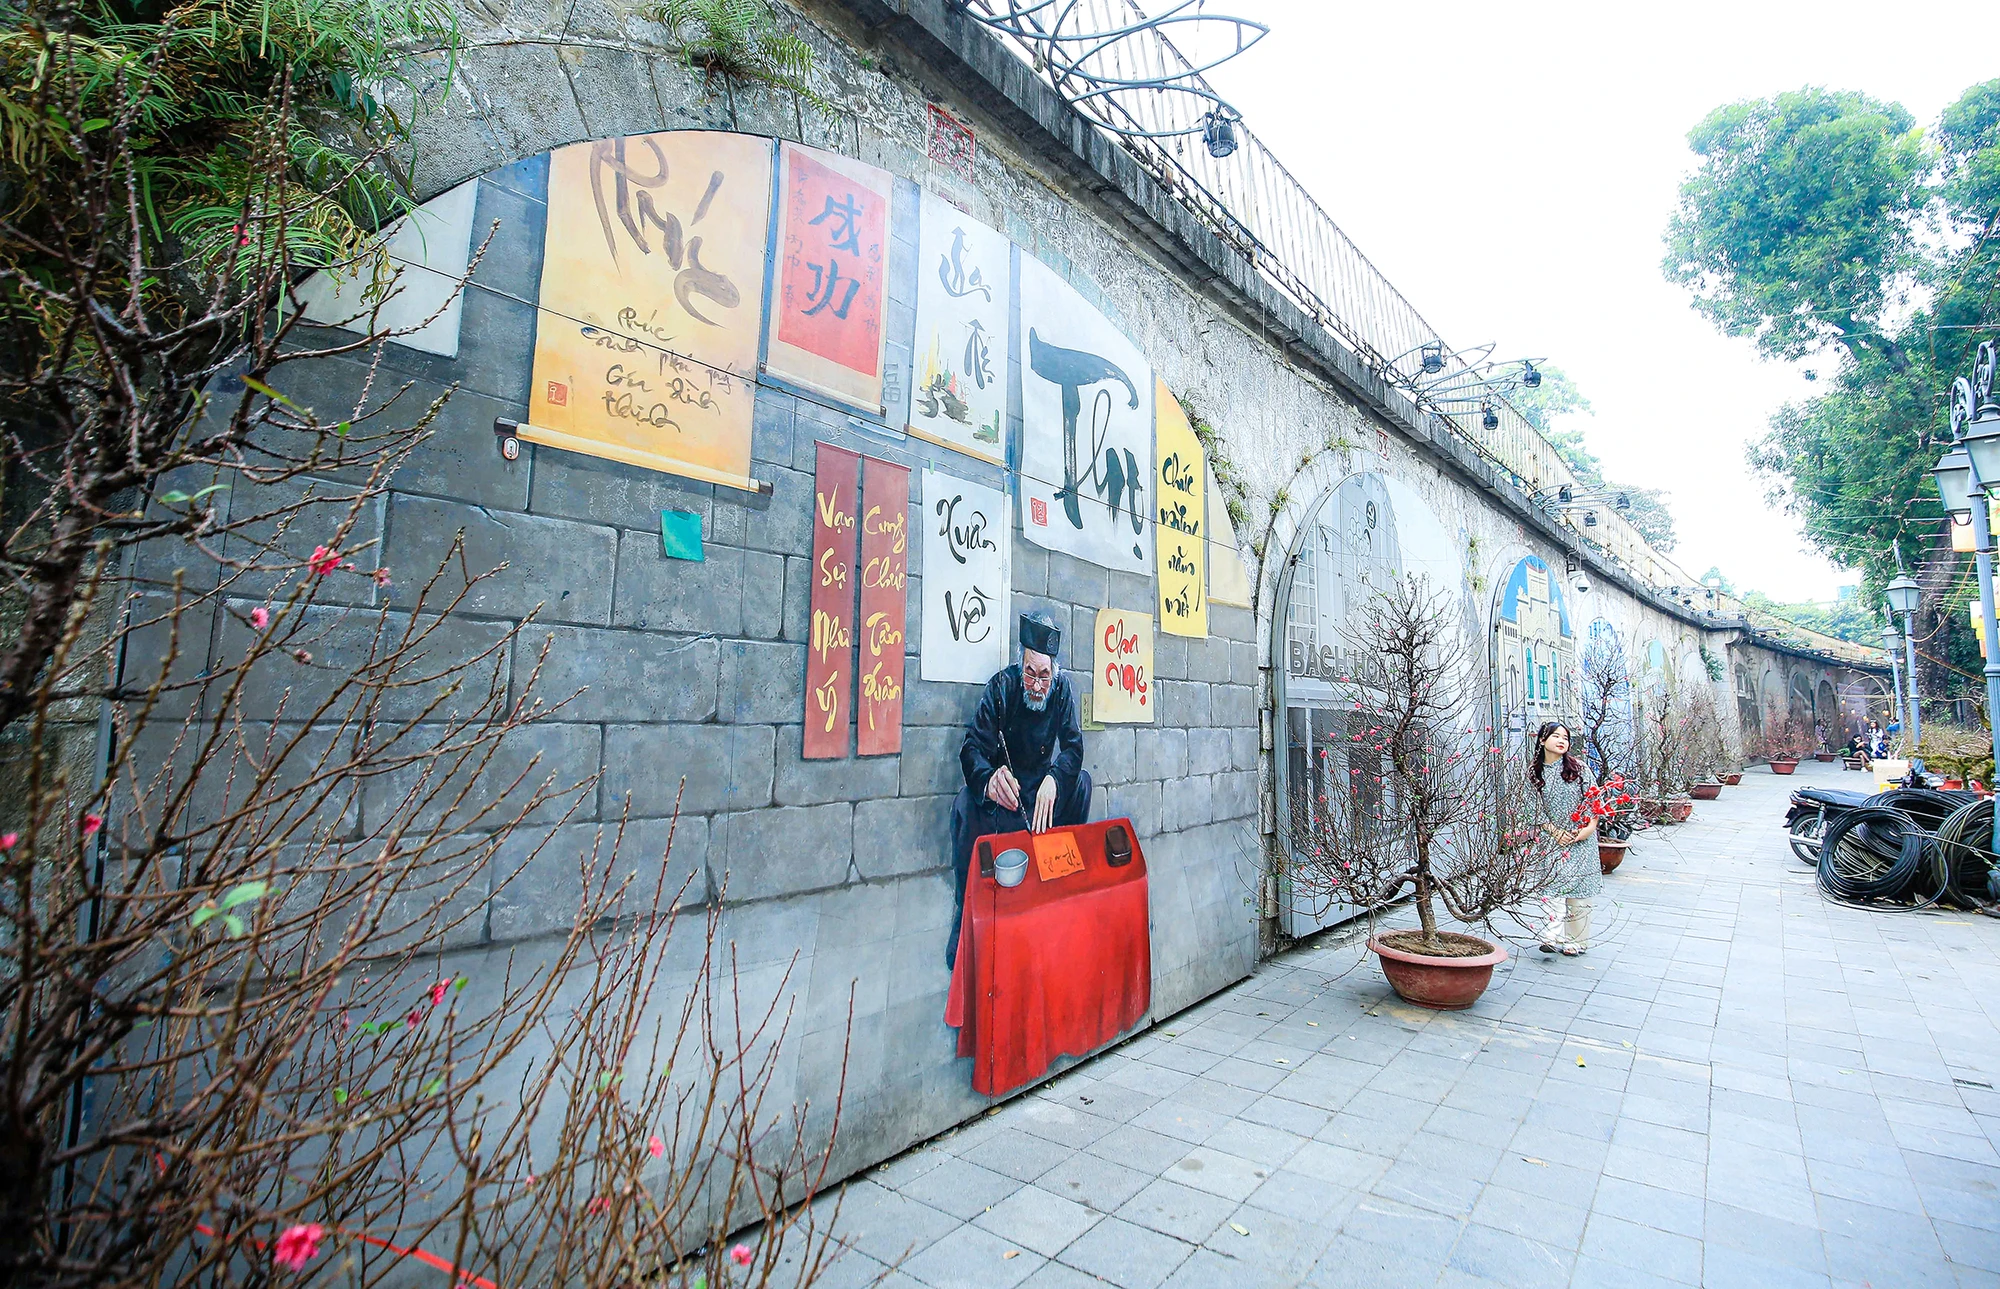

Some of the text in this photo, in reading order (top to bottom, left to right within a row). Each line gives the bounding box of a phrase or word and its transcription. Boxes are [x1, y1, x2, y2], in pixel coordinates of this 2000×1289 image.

[816, 483, 855, 534] Vạn
[864, 505, 906, 554] Cung
[819, 547, 848, 590] Sự
[863, 555, 906, 592] Chúc
[813, 608, 851, 664] Như
[866, 611, 902, 657] Tân
